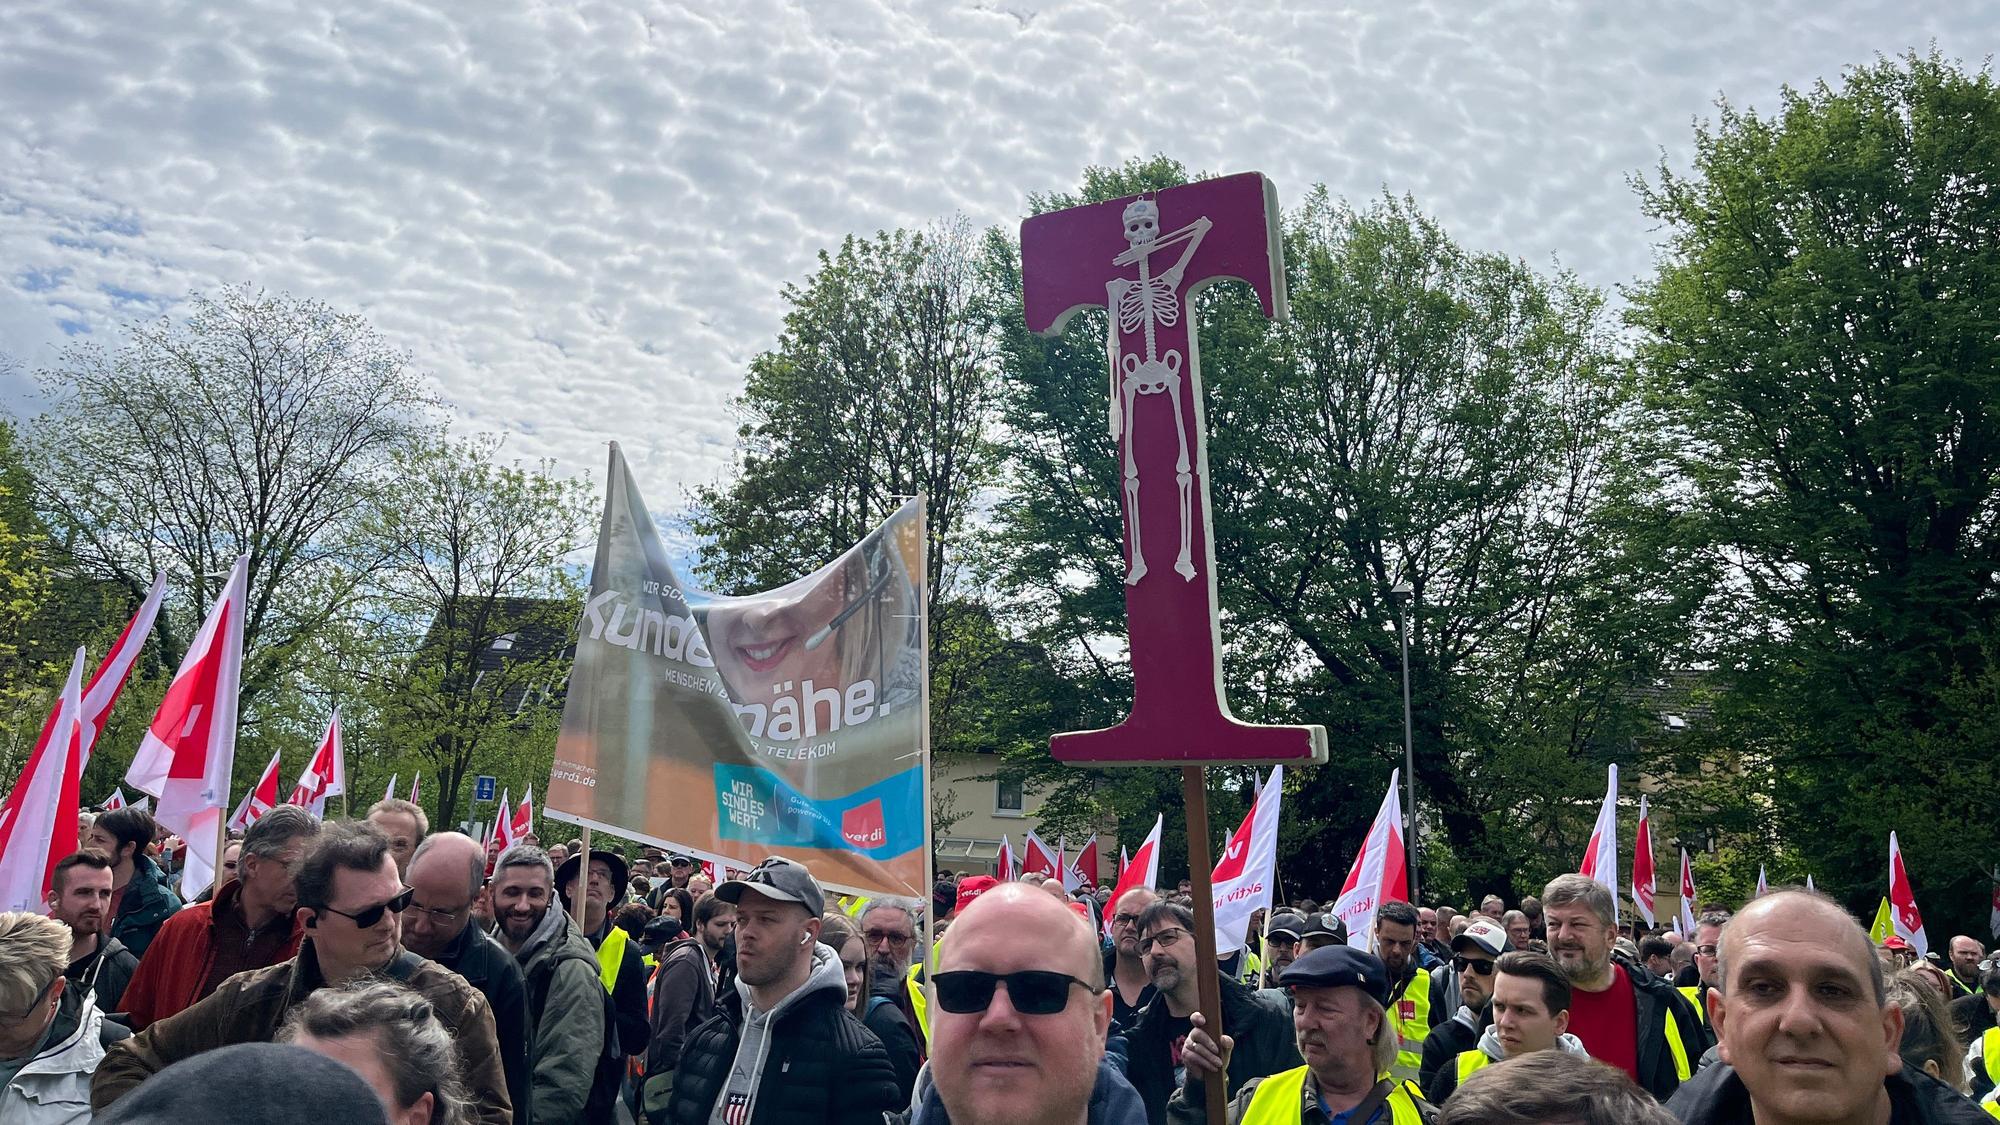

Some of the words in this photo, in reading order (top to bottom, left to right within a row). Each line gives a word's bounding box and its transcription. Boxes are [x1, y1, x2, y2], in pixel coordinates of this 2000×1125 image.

[643, 580, 659, 595] WIR
[665, 668, 716, 694] MENSCHEN
[731, 679, 890, 741] nähe.
[767, 741, 836, 760] TELEKOM
[731, 779, 754, 798] WIR
[722, 792, 748, 811] SIND
[750, 801, 765, 817] ES
[729, 808, 761, 830] WERT.
